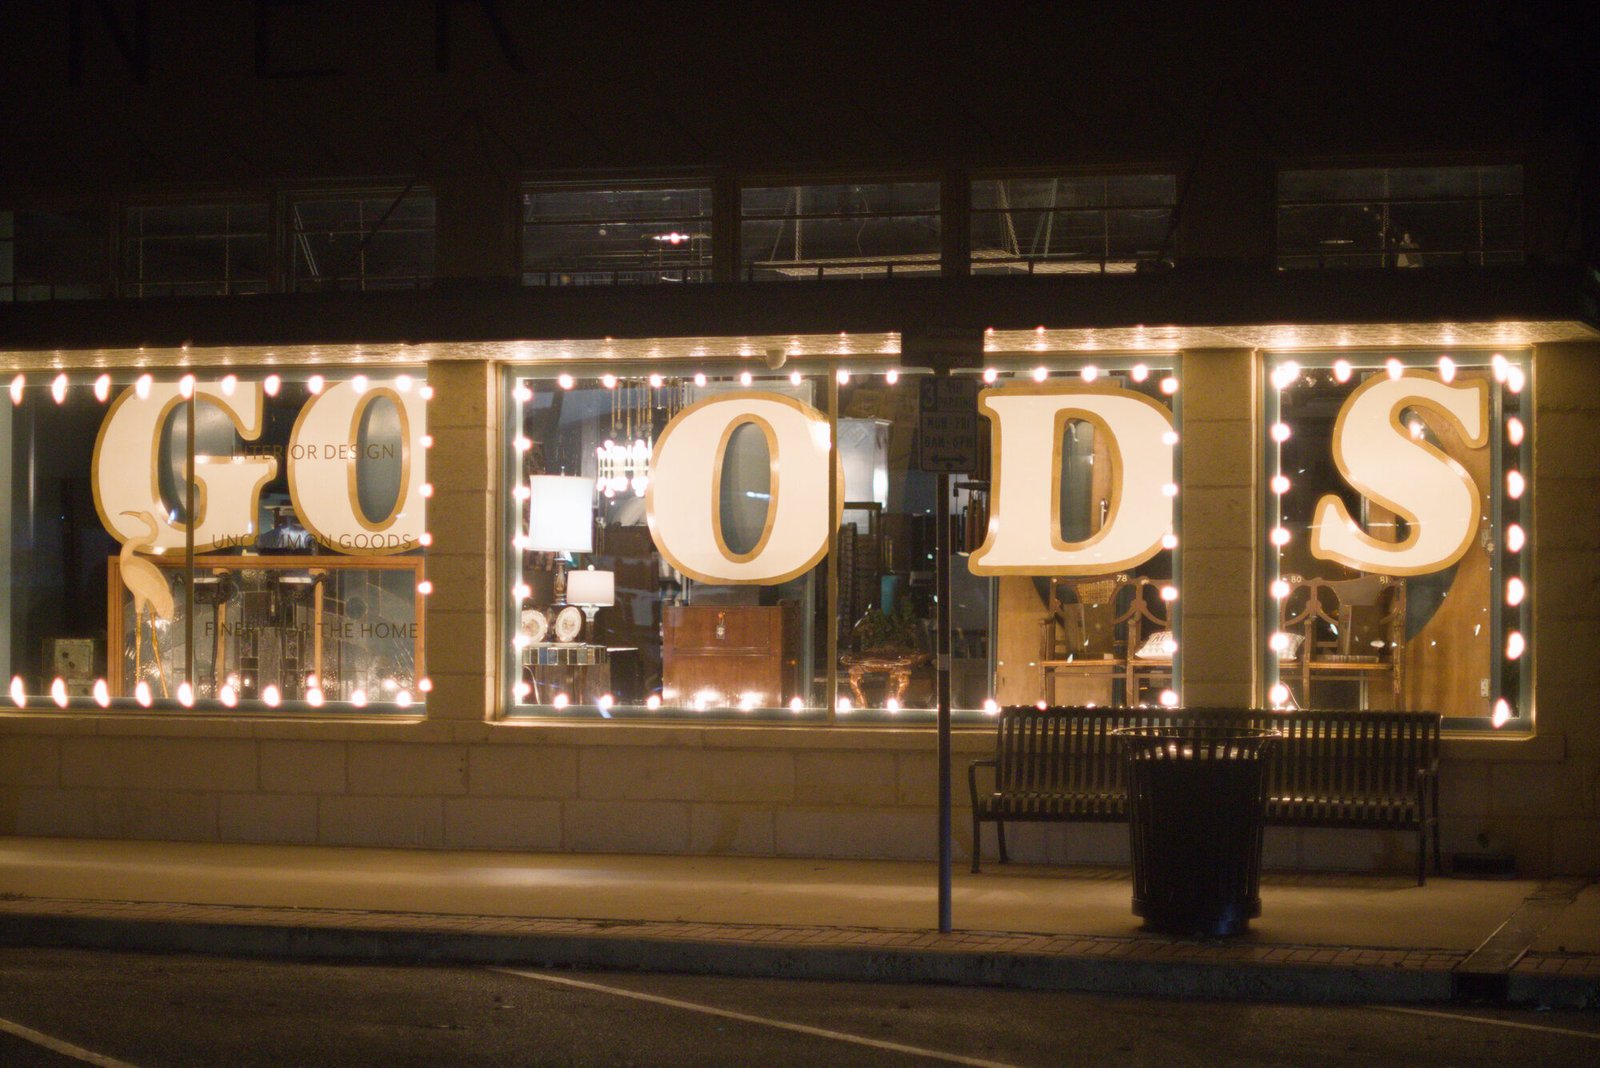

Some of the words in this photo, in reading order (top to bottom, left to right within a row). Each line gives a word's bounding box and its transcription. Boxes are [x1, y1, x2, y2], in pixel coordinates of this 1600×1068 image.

[230, 443, 317, 460] INTEROR
[324, 443, 394, 460] DESIGN
[338, 533, 412, 549] GOODS
[204, 621, 267, 638] FNERY
[316, 622, 353, 639] THE
[360, 622, 419, 639] HOME
